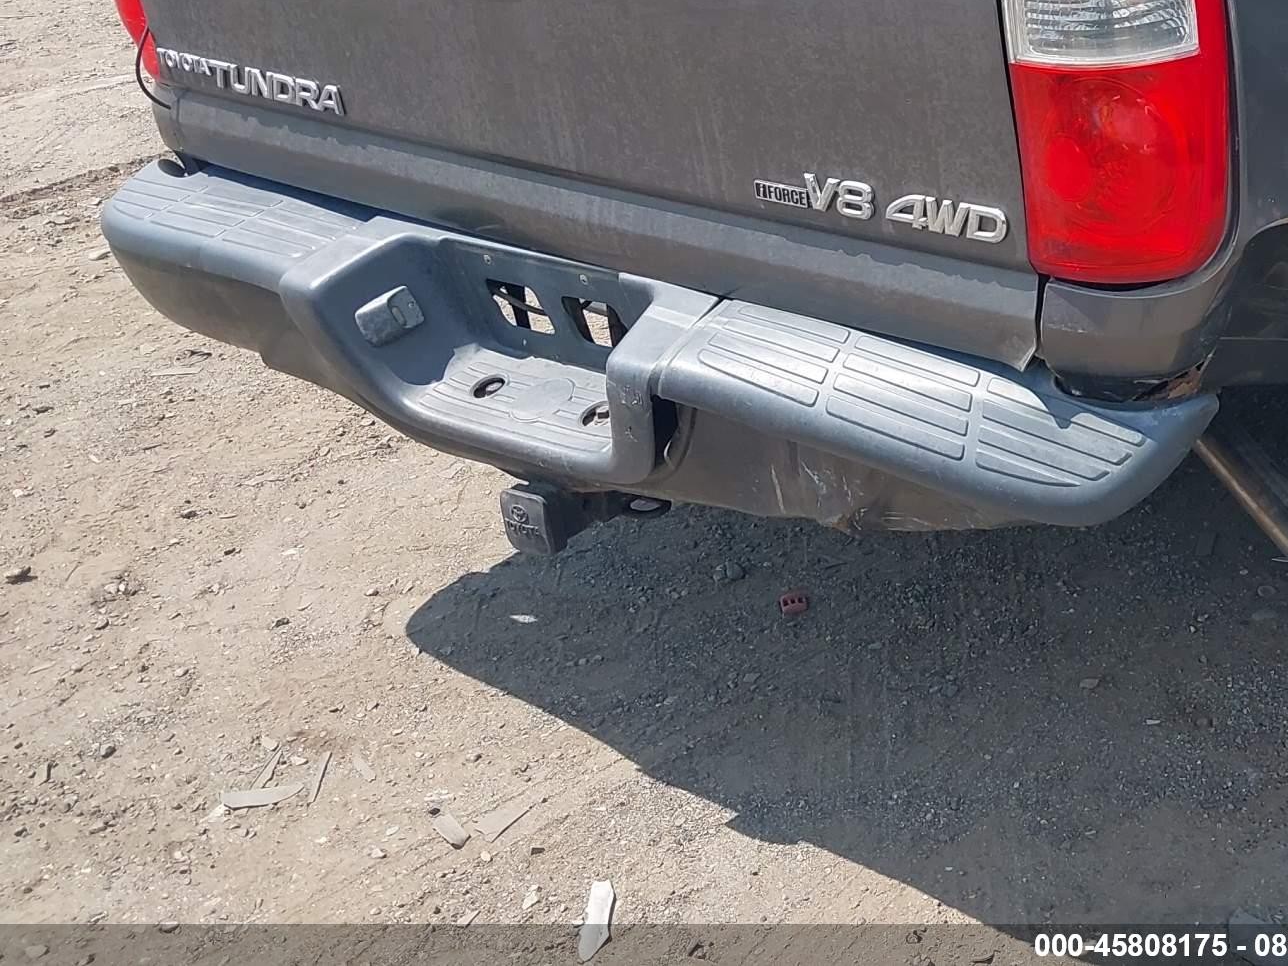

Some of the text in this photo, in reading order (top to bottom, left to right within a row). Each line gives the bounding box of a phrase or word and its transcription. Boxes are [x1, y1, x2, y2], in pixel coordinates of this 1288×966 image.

[157, 47, 347, 116] TOYOTA TUNDRA
[803, 172, 875, 221] V8
[885, 194, 1008, 244] 4WD
